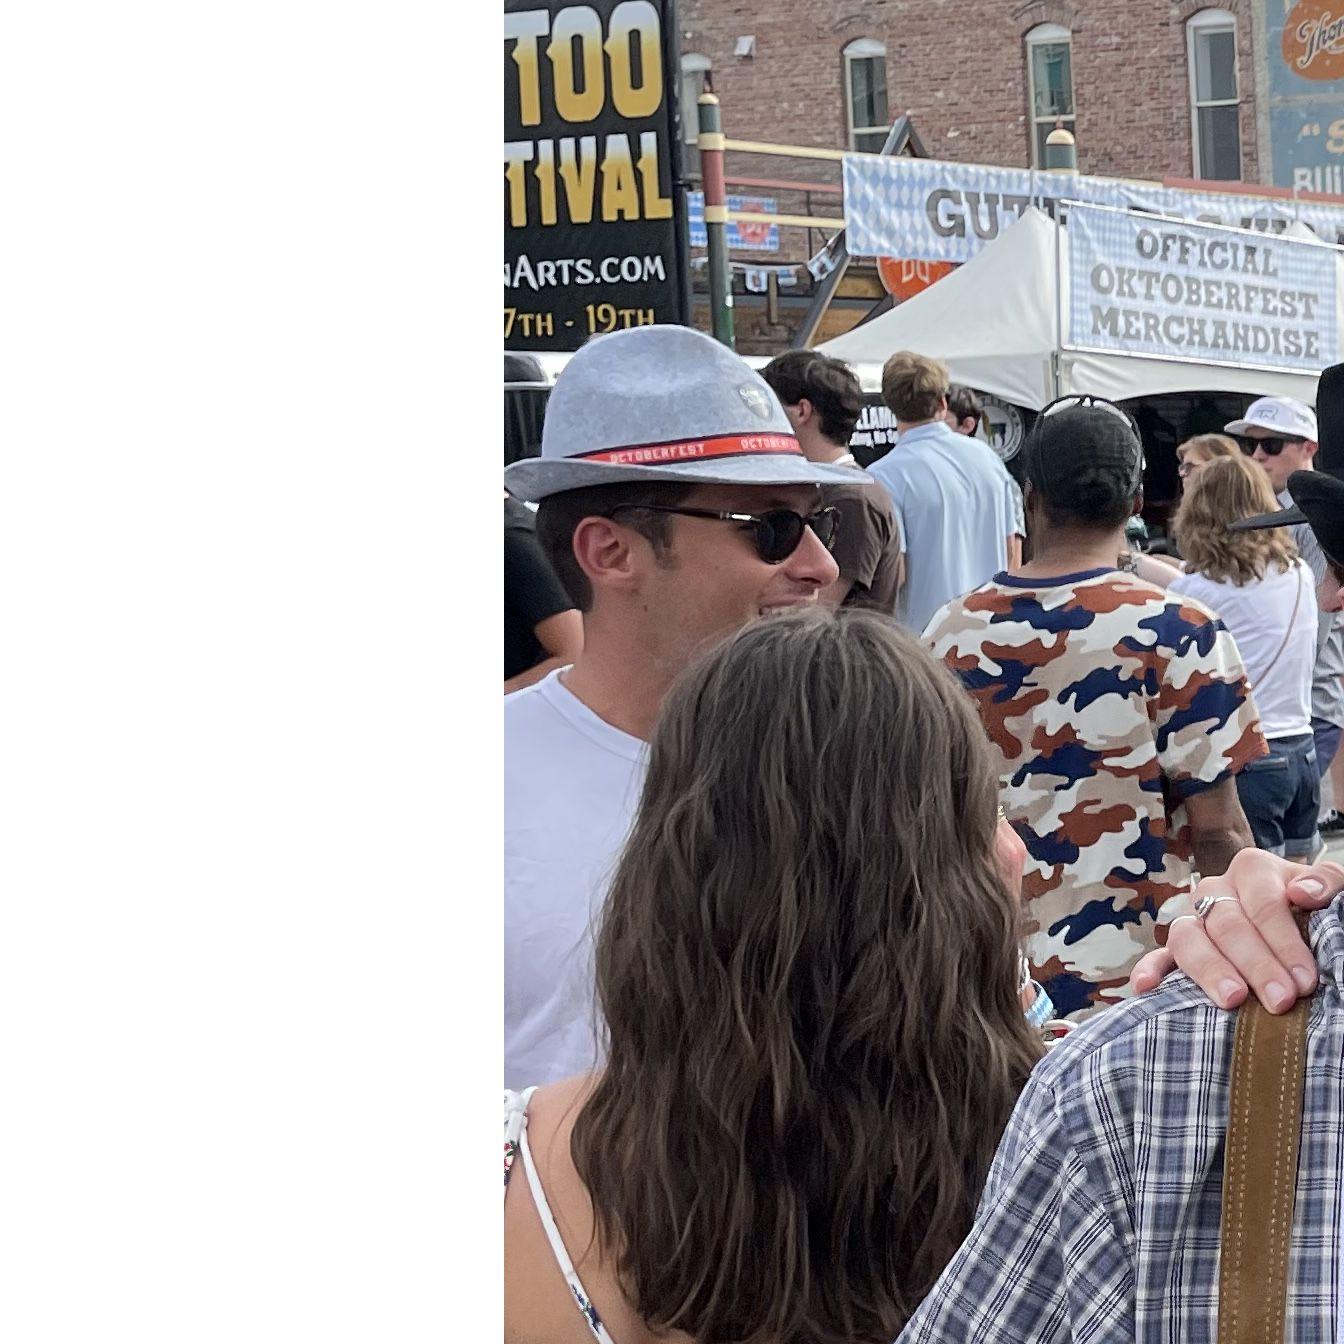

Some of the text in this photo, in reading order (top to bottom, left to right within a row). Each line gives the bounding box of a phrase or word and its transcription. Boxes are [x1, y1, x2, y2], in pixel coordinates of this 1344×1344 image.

[1135, 228, 1279, 278] OFFICIAL
[1090, 263, 1319, 321] OKTOBERFEST
[1090, 304, 1320, 360] MERCHANDISE
